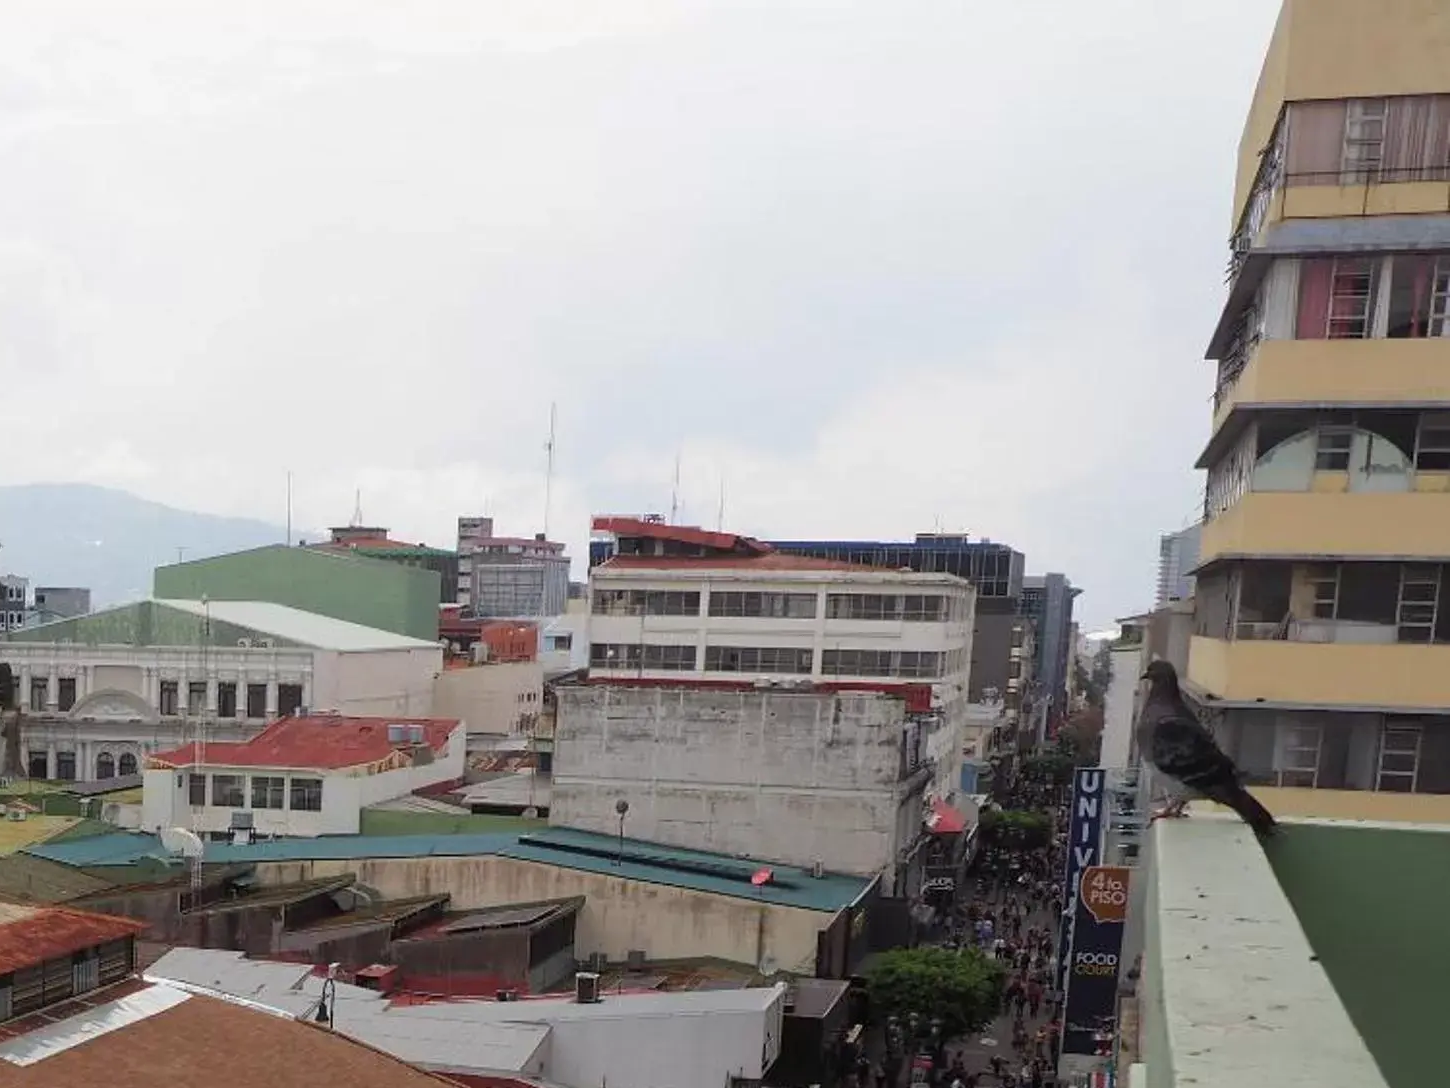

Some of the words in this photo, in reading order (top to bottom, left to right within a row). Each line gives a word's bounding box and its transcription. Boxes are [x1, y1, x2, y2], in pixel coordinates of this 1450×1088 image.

[1090, 889, 1126, 906] PISO
[1077, 952, 1118, 965] FOOD
[1075, 963, 1116, 976] COURT
